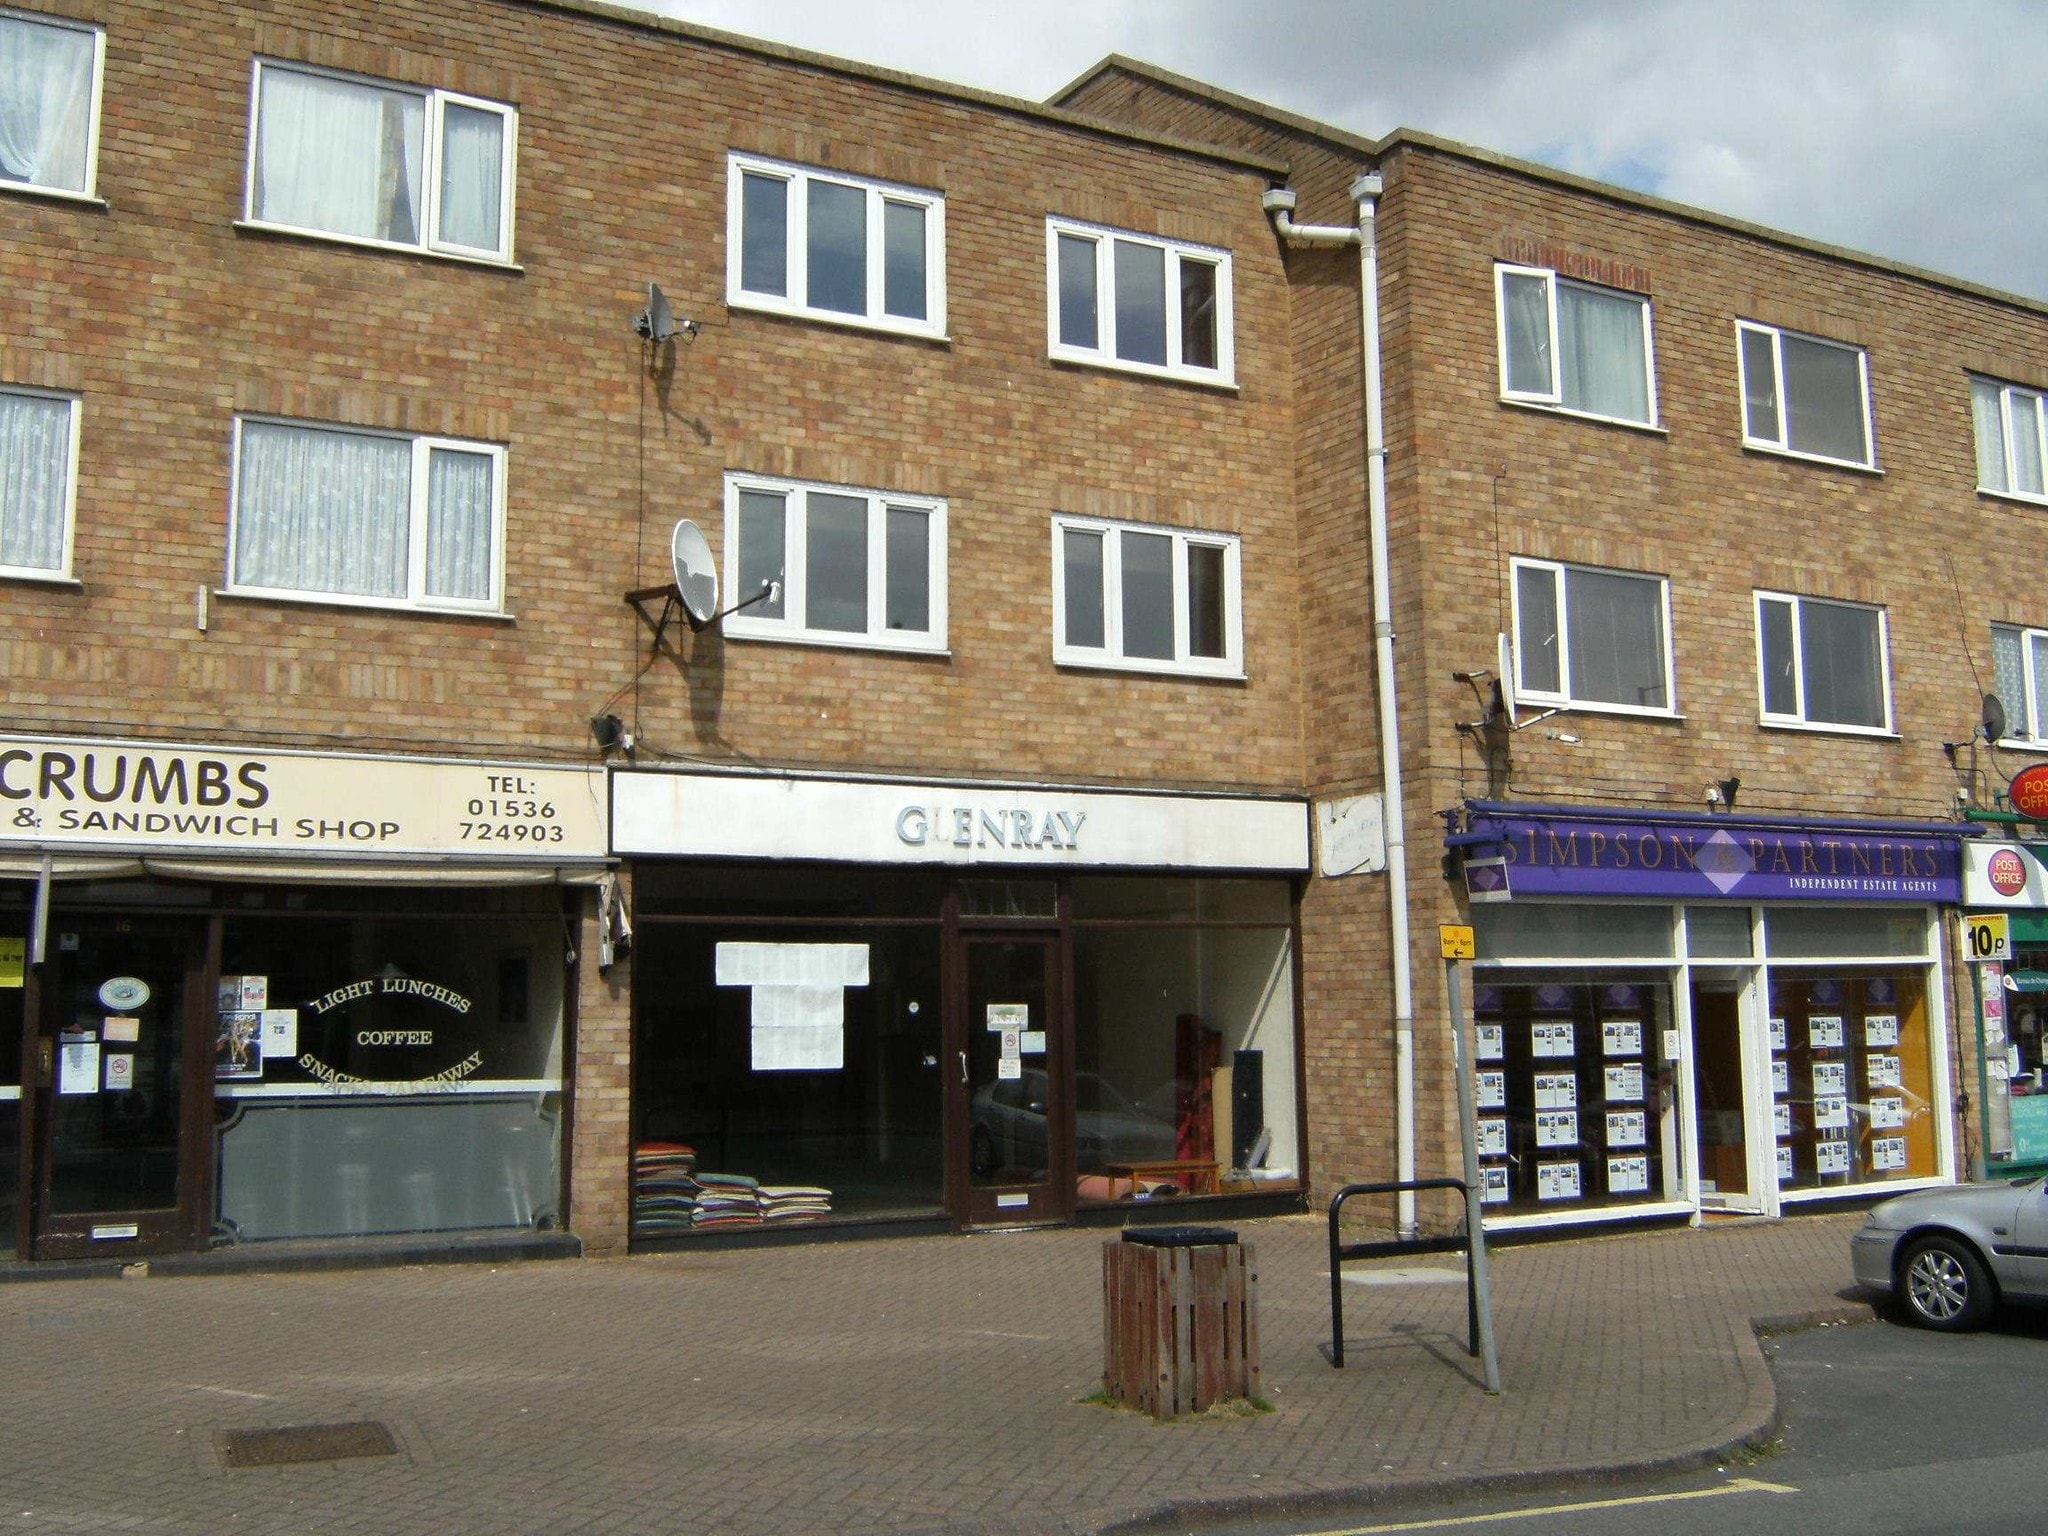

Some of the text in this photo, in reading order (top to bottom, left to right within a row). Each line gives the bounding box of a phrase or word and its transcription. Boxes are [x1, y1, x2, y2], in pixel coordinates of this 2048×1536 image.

[0, 750, 270, 809] CRUMBS
[488, 776, 536, 794] TEL:
[467, 799, 556, 818] 01536
[12, 807, 400, 841] & SANDWICH SHOP
[459, 822, 564, 842] 724903
[895, 805, 1087, 851] GLENRAY
[1748, 838, 1938, 877] PARTNERS
[1995, 860, 2017, 871] POST
[1789, 878, 1938, 892] INDEPENDENT ESTATE AGENTS
[1992, 873, 2022, 884] OFFICE
[312, 978, 472, 1014] LIGHT LUNCHES
[357, 1031, 433, 1045] COFFEE
